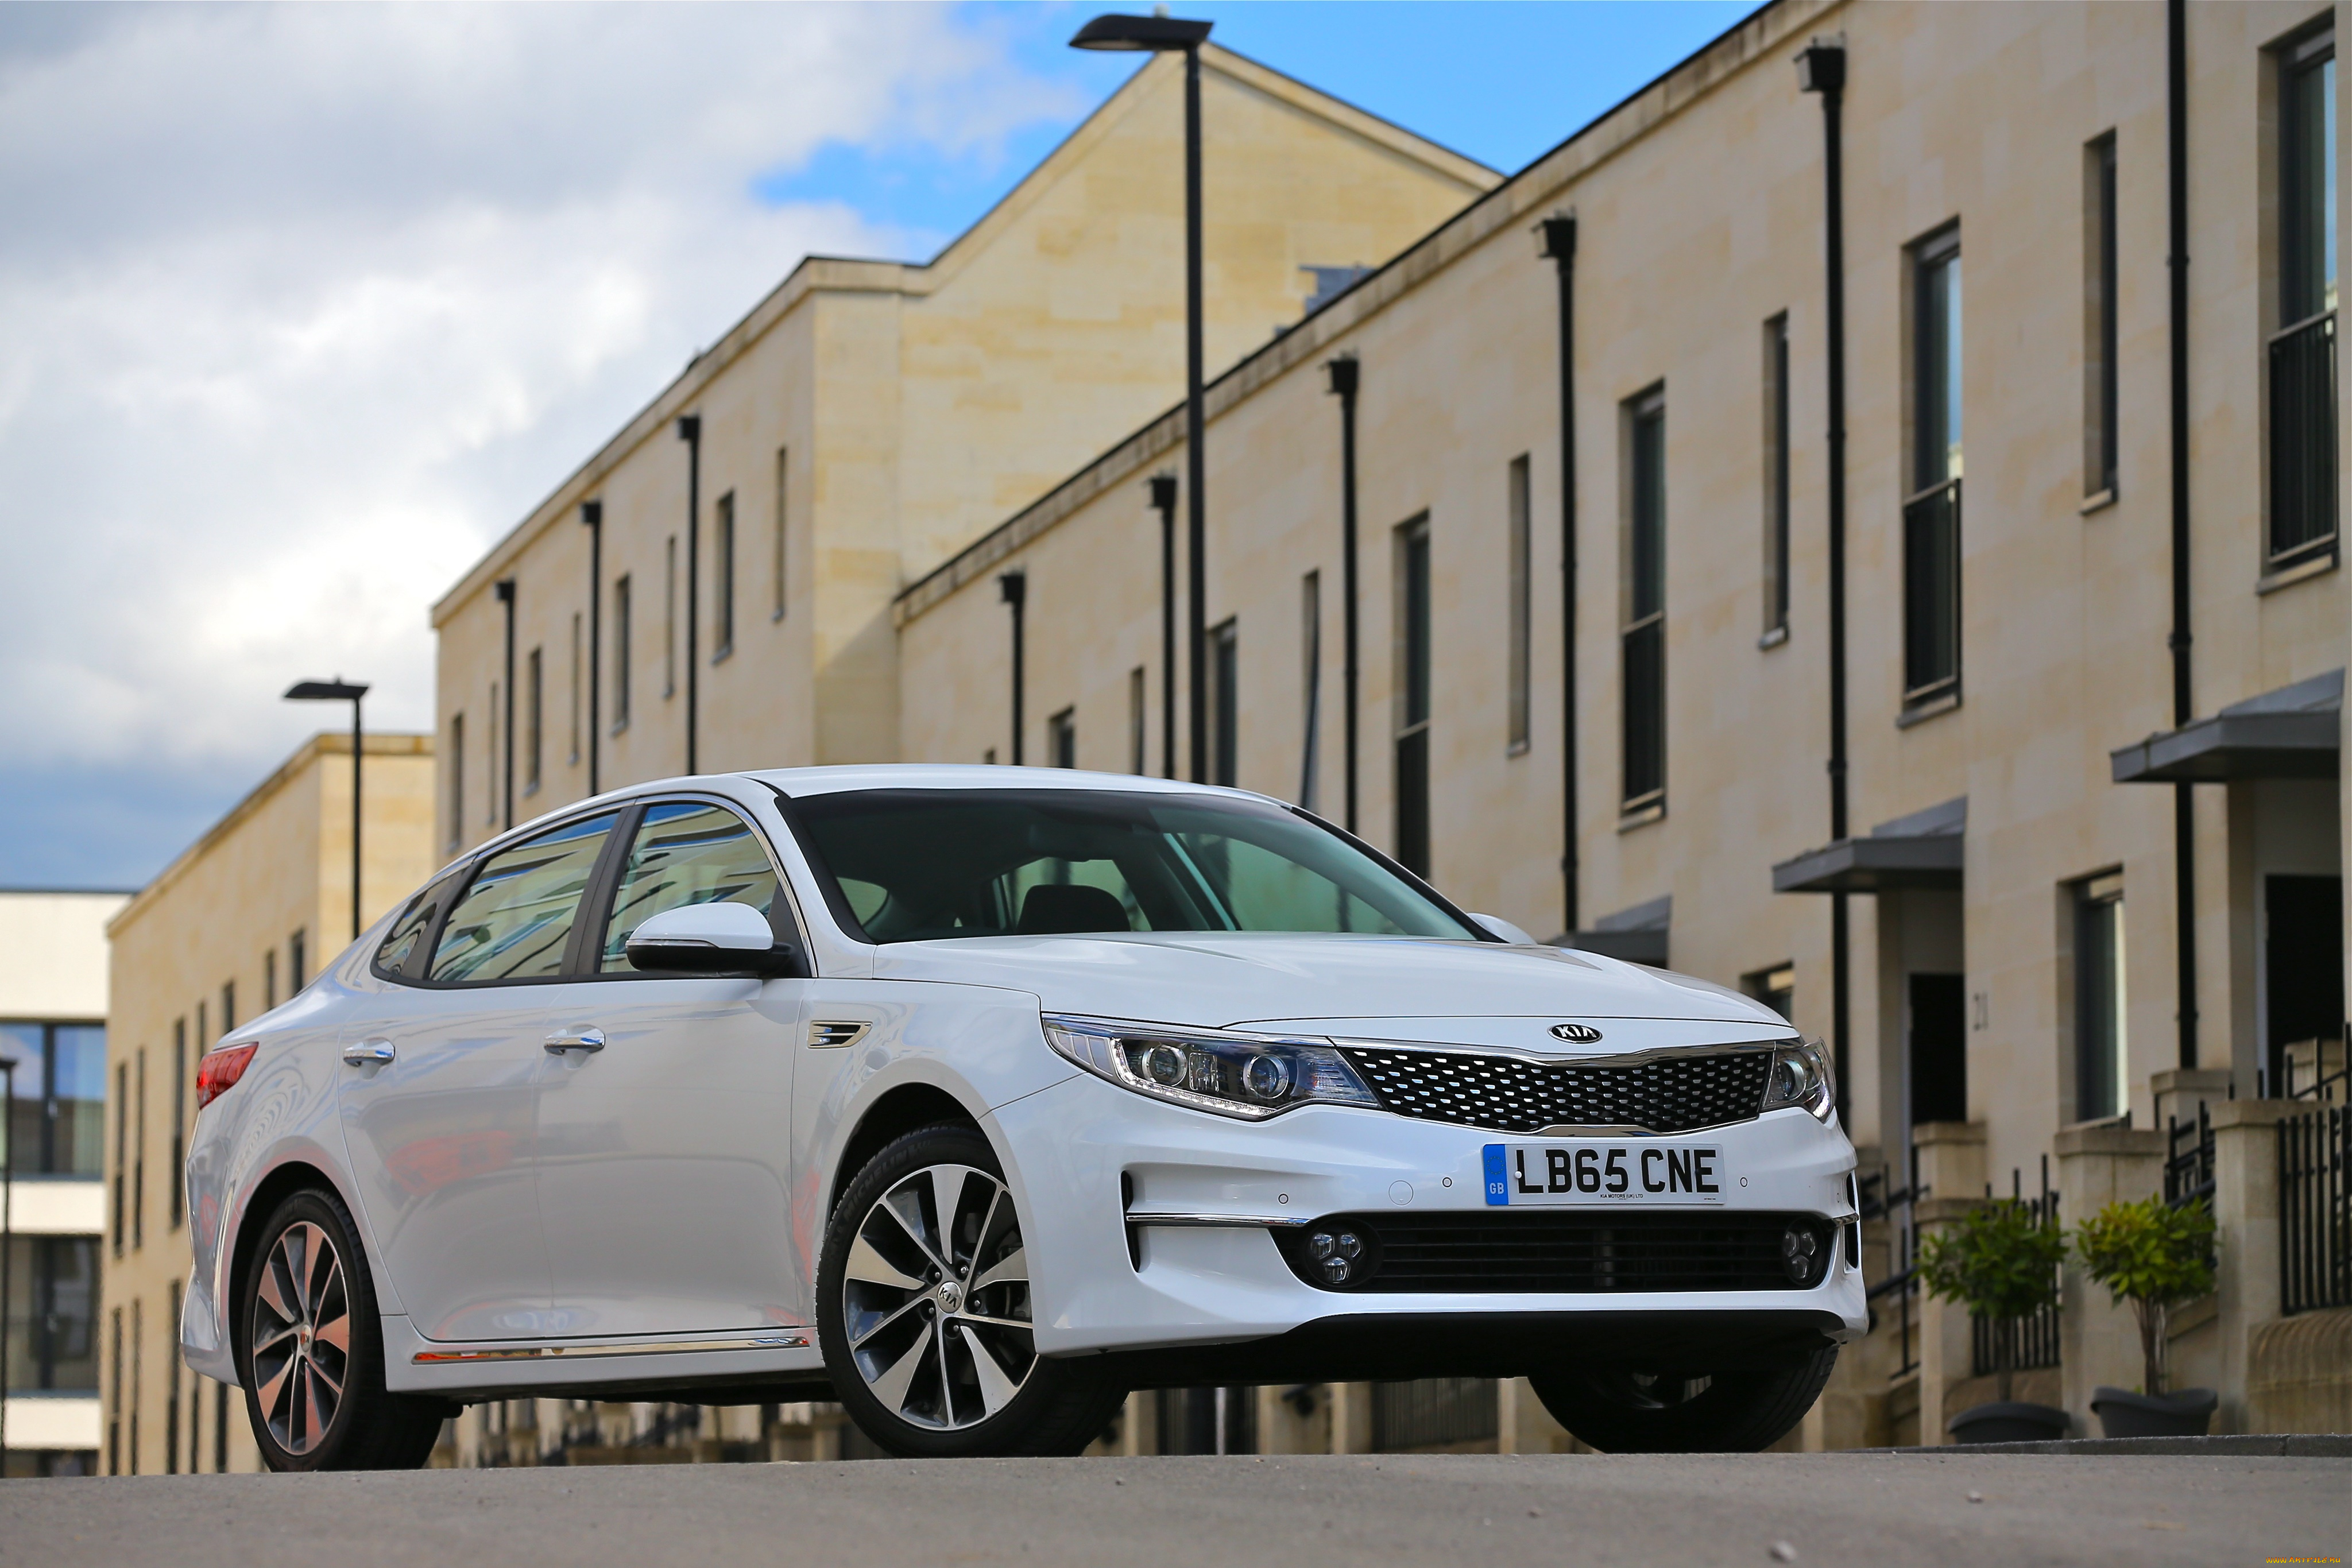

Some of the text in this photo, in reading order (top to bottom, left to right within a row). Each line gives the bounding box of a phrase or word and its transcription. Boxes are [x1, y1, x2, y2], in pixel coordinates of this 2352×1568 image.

[1556, 1025, 1597, 1038] KIA
[1515, 1149, 1719, 1194] LB65 CNE
[1490, 1183, 1504, 1194] GB
[939, 1287, 957, 1308] KIA
